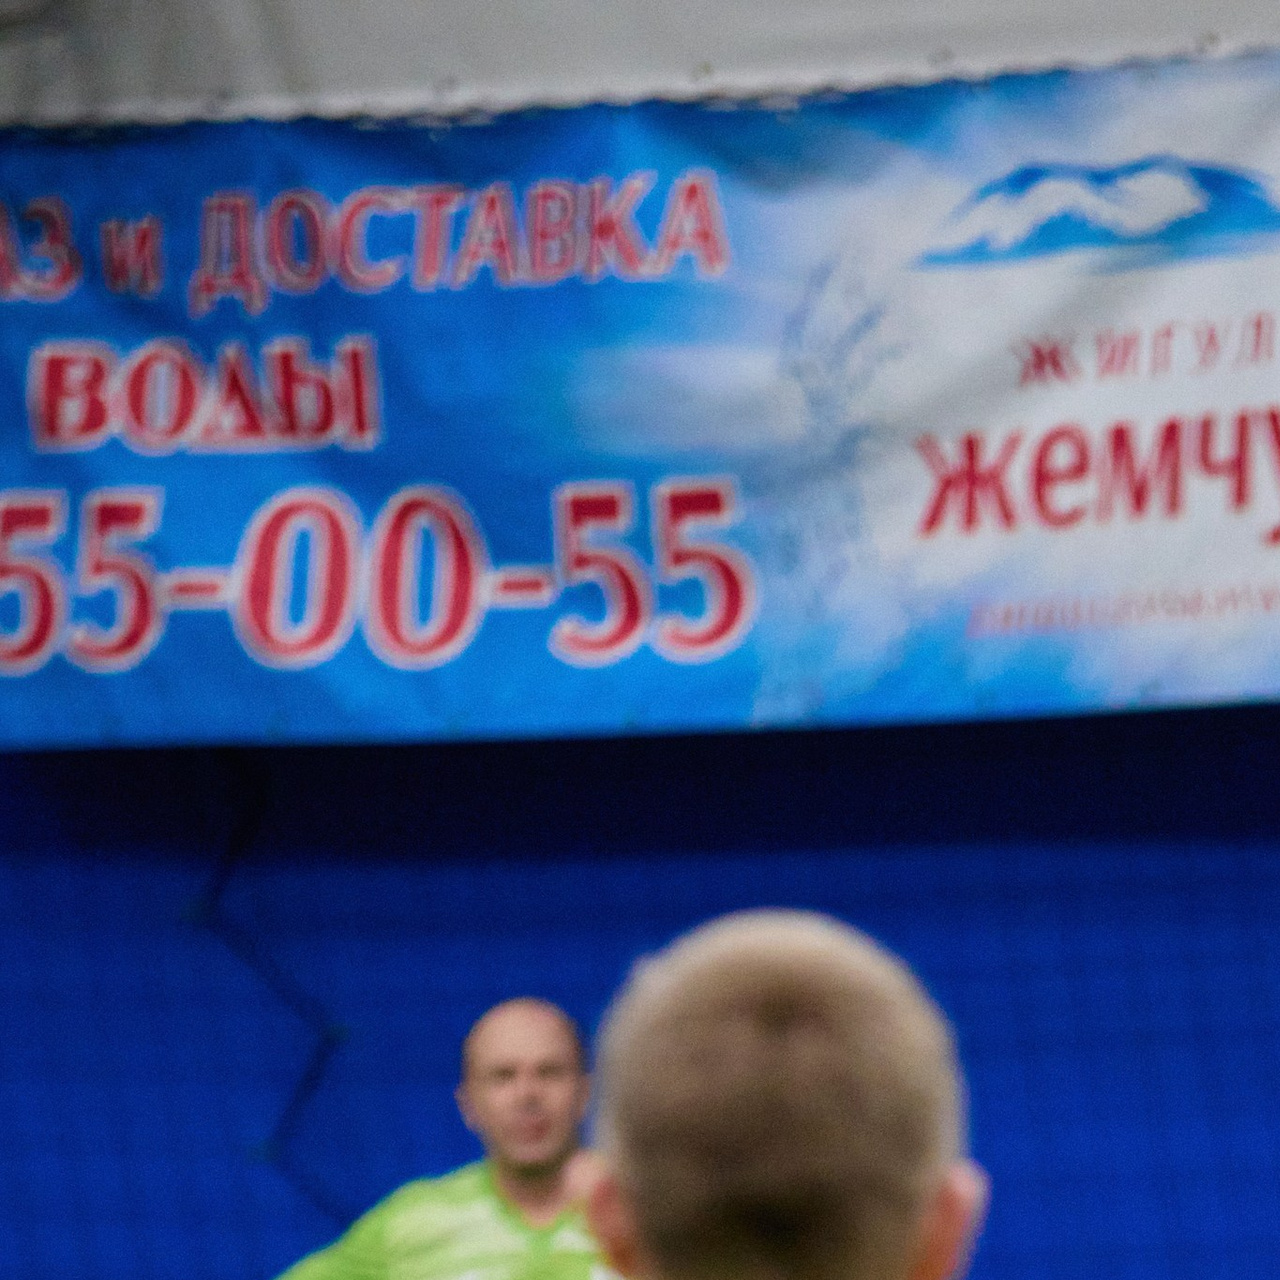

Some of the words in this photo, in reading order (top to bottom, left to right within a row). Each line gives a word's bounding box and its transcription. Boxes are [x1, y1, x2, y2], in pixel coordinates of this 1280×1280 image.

[188, 168, 731, 319] ДОСТАВКА
[28, 335, 383, 454] ВОДЫ
[0, 475, 758, 678] 55-00-55
